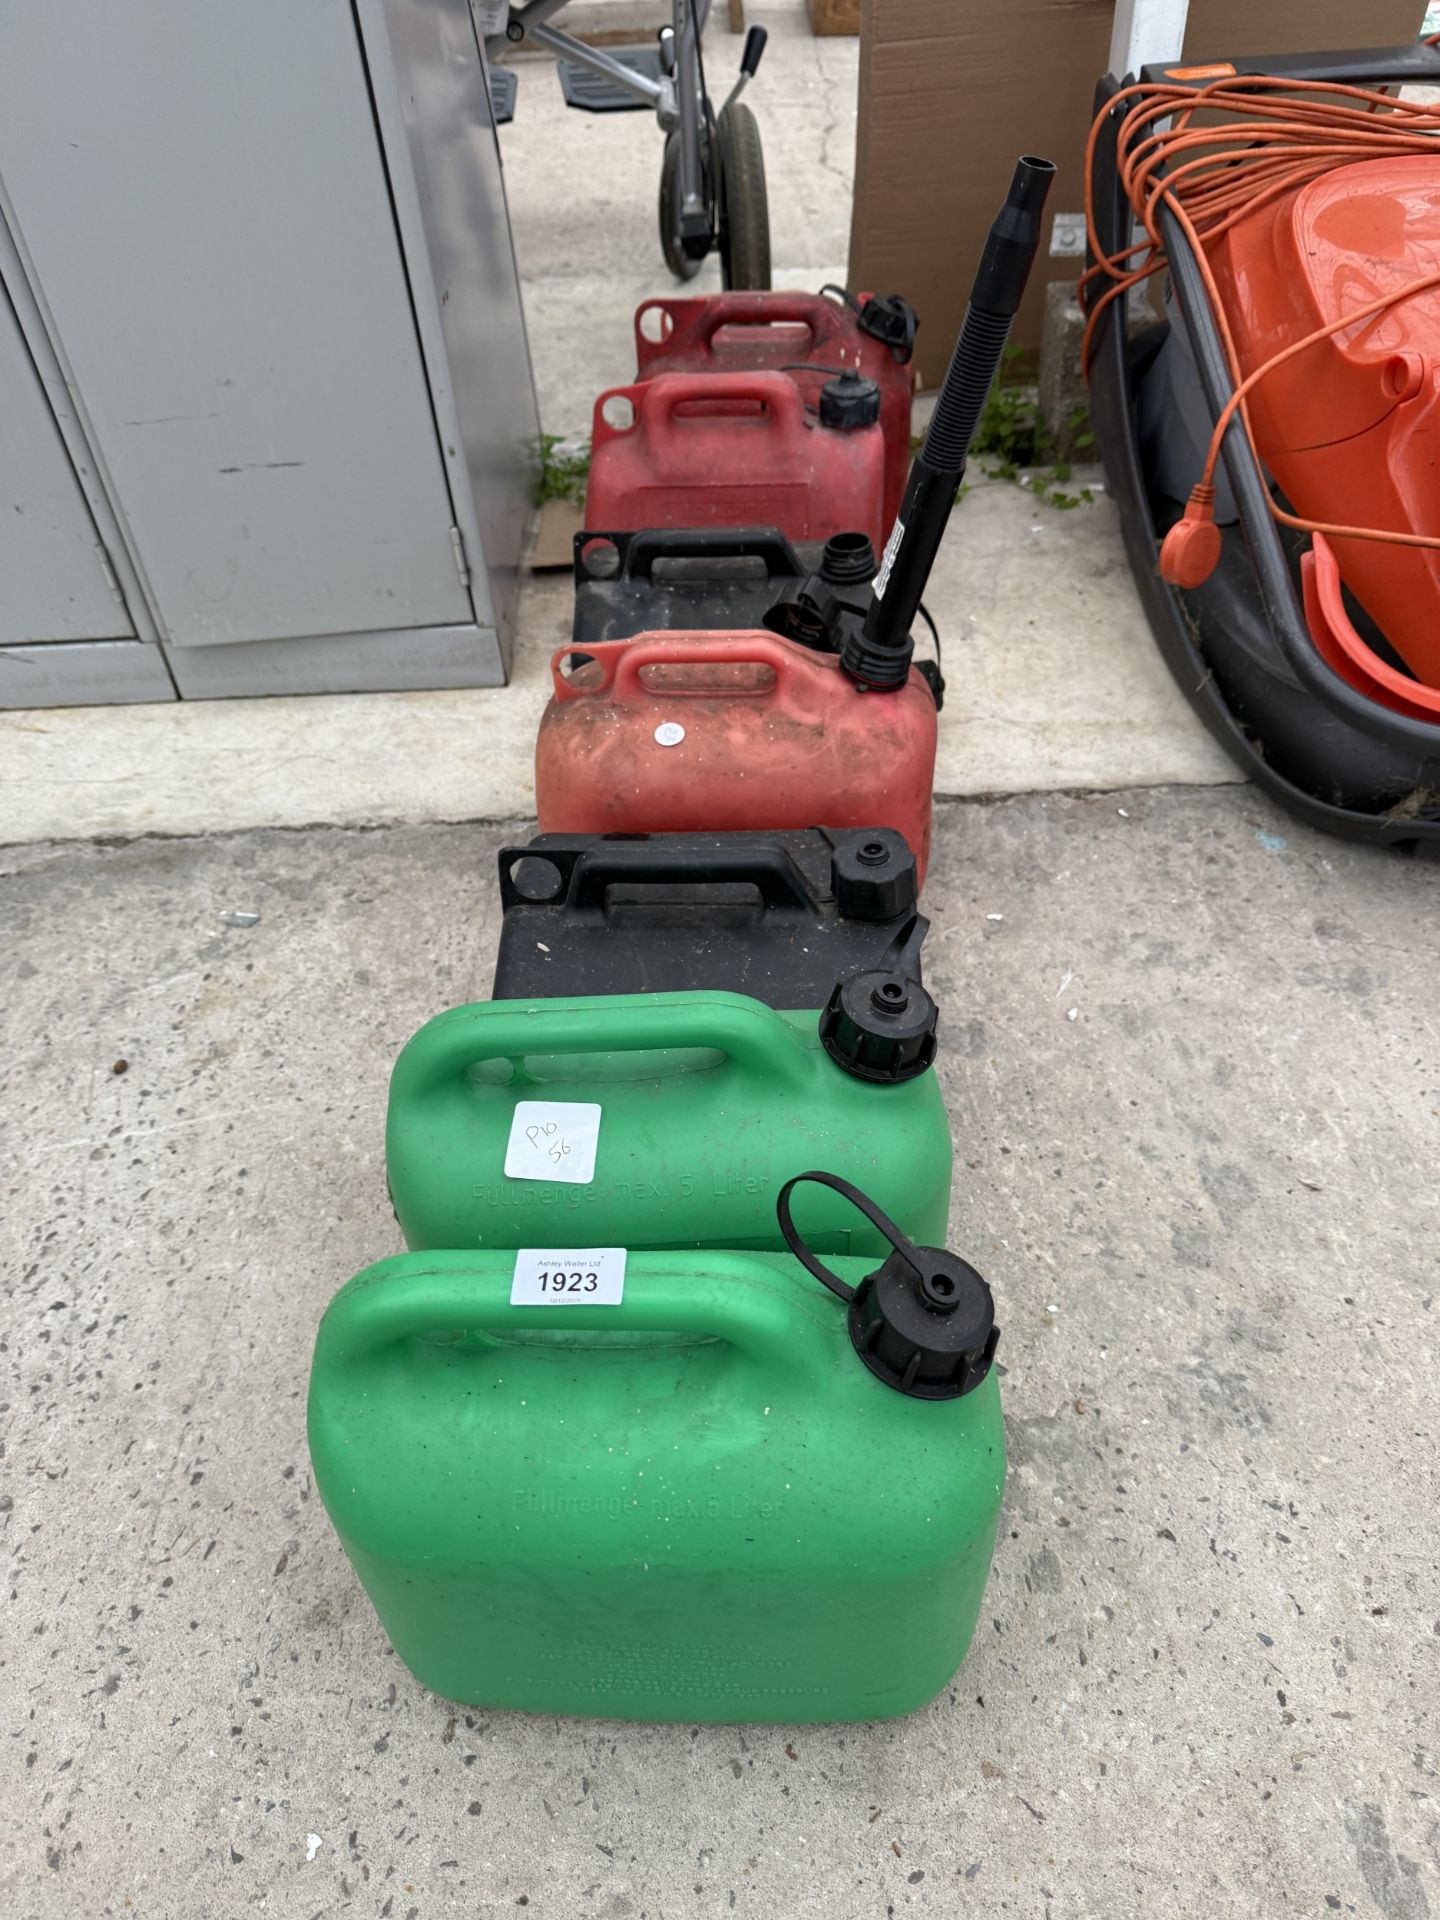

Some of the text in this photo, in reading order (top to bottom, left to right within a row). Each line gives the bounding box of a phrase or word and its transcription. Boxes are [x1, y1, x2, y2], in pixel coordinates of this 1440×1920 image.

[680, 1174, 694, 1196] 5
[712, 1173, 769, 1196] Liter
[537, 1260, 562, 1268] Ashley
[538, 1272, 598, 1292] 1923
